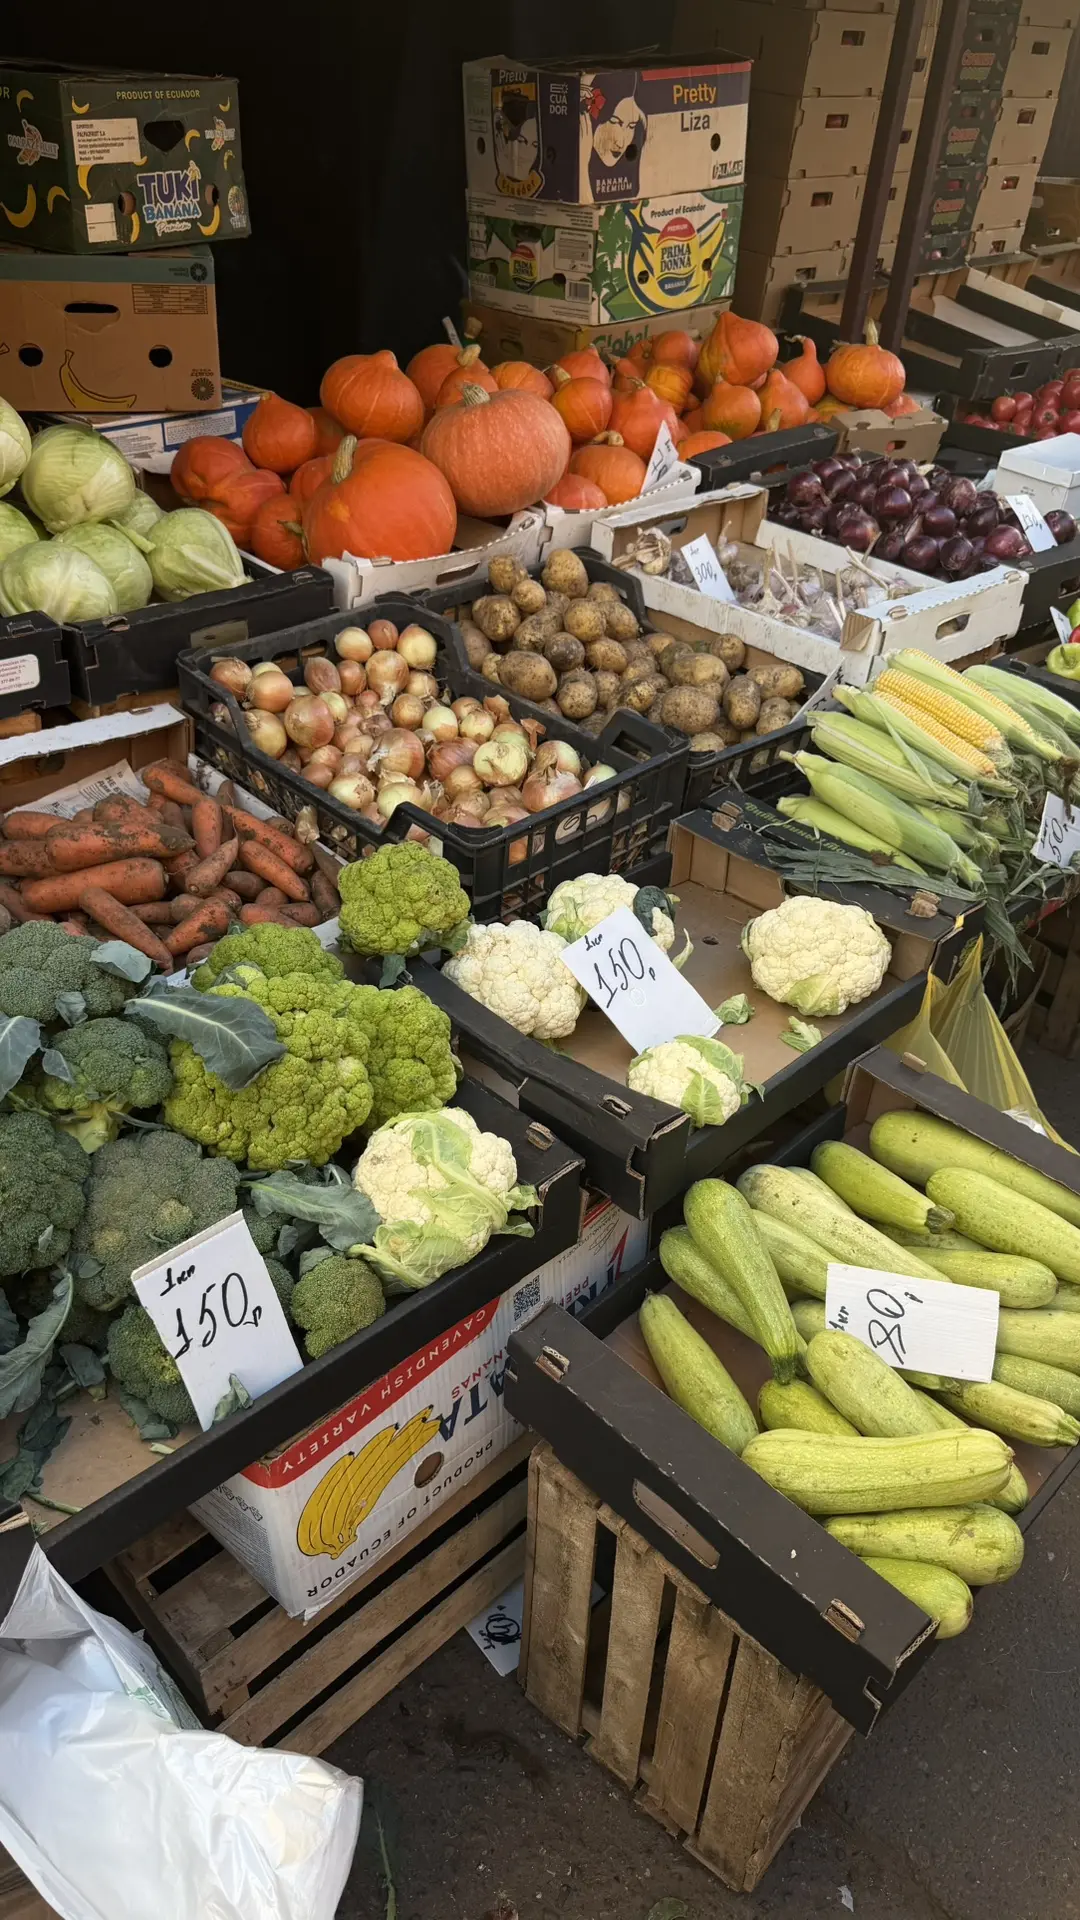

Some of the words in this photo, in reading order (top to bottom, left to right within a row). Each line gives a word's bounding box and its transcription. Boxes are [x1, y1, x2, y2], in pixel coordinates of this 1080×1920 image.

[116, 90, 153, 100] PRODUCT
[154, 90, 164, 99] OF
[166, 89, 201, 99] ECUADOR
[672, 83, 717, 105] Pretty
[680, 112, 710, 132] Liza
[138, 170, 200, 205] TUKI
[596, 176, 628, 187] BANANA
[596, 182, 633, 194] PREMIUM
[145, 202, 201, 222] BANANA
[650, 207, 674, 219] Product
[674, 206, 682, 214] of
[682, 203, 707, 214] Ecuador
[156, 221, 192, 236] Premium
[661, 243, 692, 261] PRIMA
[660, 256, 692, 273] DONNA
[380, 1309, 486, 1400] CAVENDISH
[281, 1403, 372, 1474] VARIETY
[424, 1439, 493, 1506] PRODUCT
[397, 1507, 418, 1529] OF
[306, 1529, 392, 1598] ECUADOR
